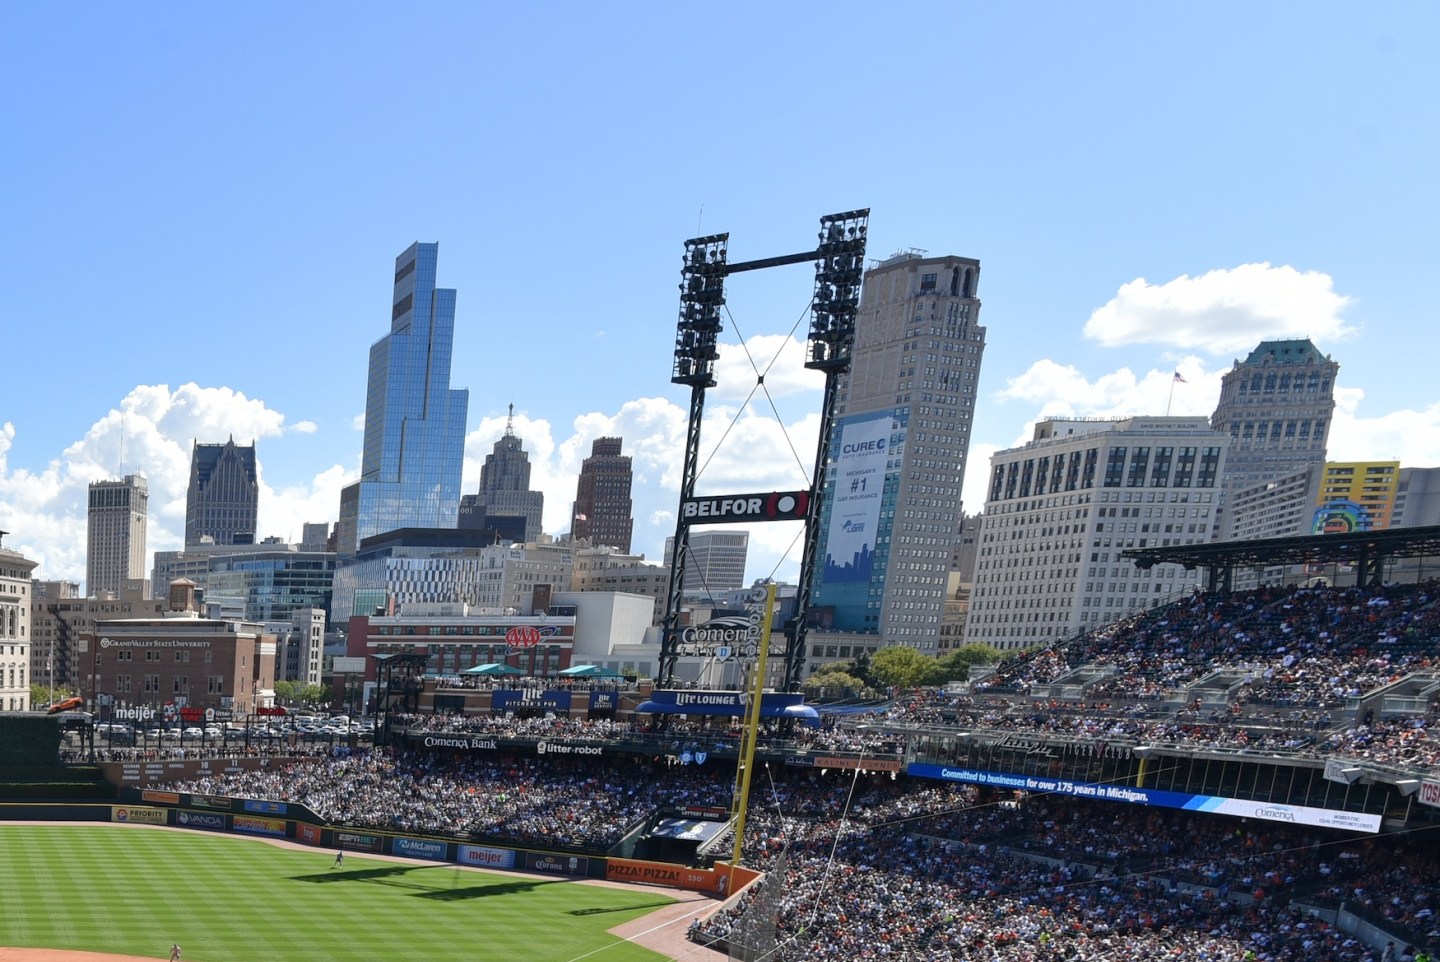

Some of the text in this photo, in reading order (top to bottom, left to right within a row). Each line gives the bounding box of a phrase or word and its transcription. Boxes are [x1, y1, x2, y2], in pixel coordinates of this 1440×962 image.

[844, 441, 874, 454] CURE
[847, 468, 876, 477] MICHIGAN'S
[850, 478, 867, 492] #1
[851, 493, 878, 501] INSURANCE
[685, 499, 762, 517] BELFOR
[509, 628, 540, 647] AAA
[744, 604, 766, 662] Rocket
[522, 688, 543, 701] Lite
[676, 693, 734, 705] Lite LOUNGE
[116, 707, 156, 721] meijer
[472, 739, 497, 749] Bank
[548, 743, 602, 754] litter-robot
[1029, 742, 1059, 758] City
[1062, 743, 1130, 759] TIGER CLUB
[942, 769, 1148, 802] Committed to businesses for over 175 years in Michigan.
[189, 815, 221, 824] VANDA
[410, 841, 441, 852] McLaren
[469, 850, 502, 864] meijer
[536, 860, 562, 870] Corona
[608, 864, 680, 881] PIZZA! PIZZA!
